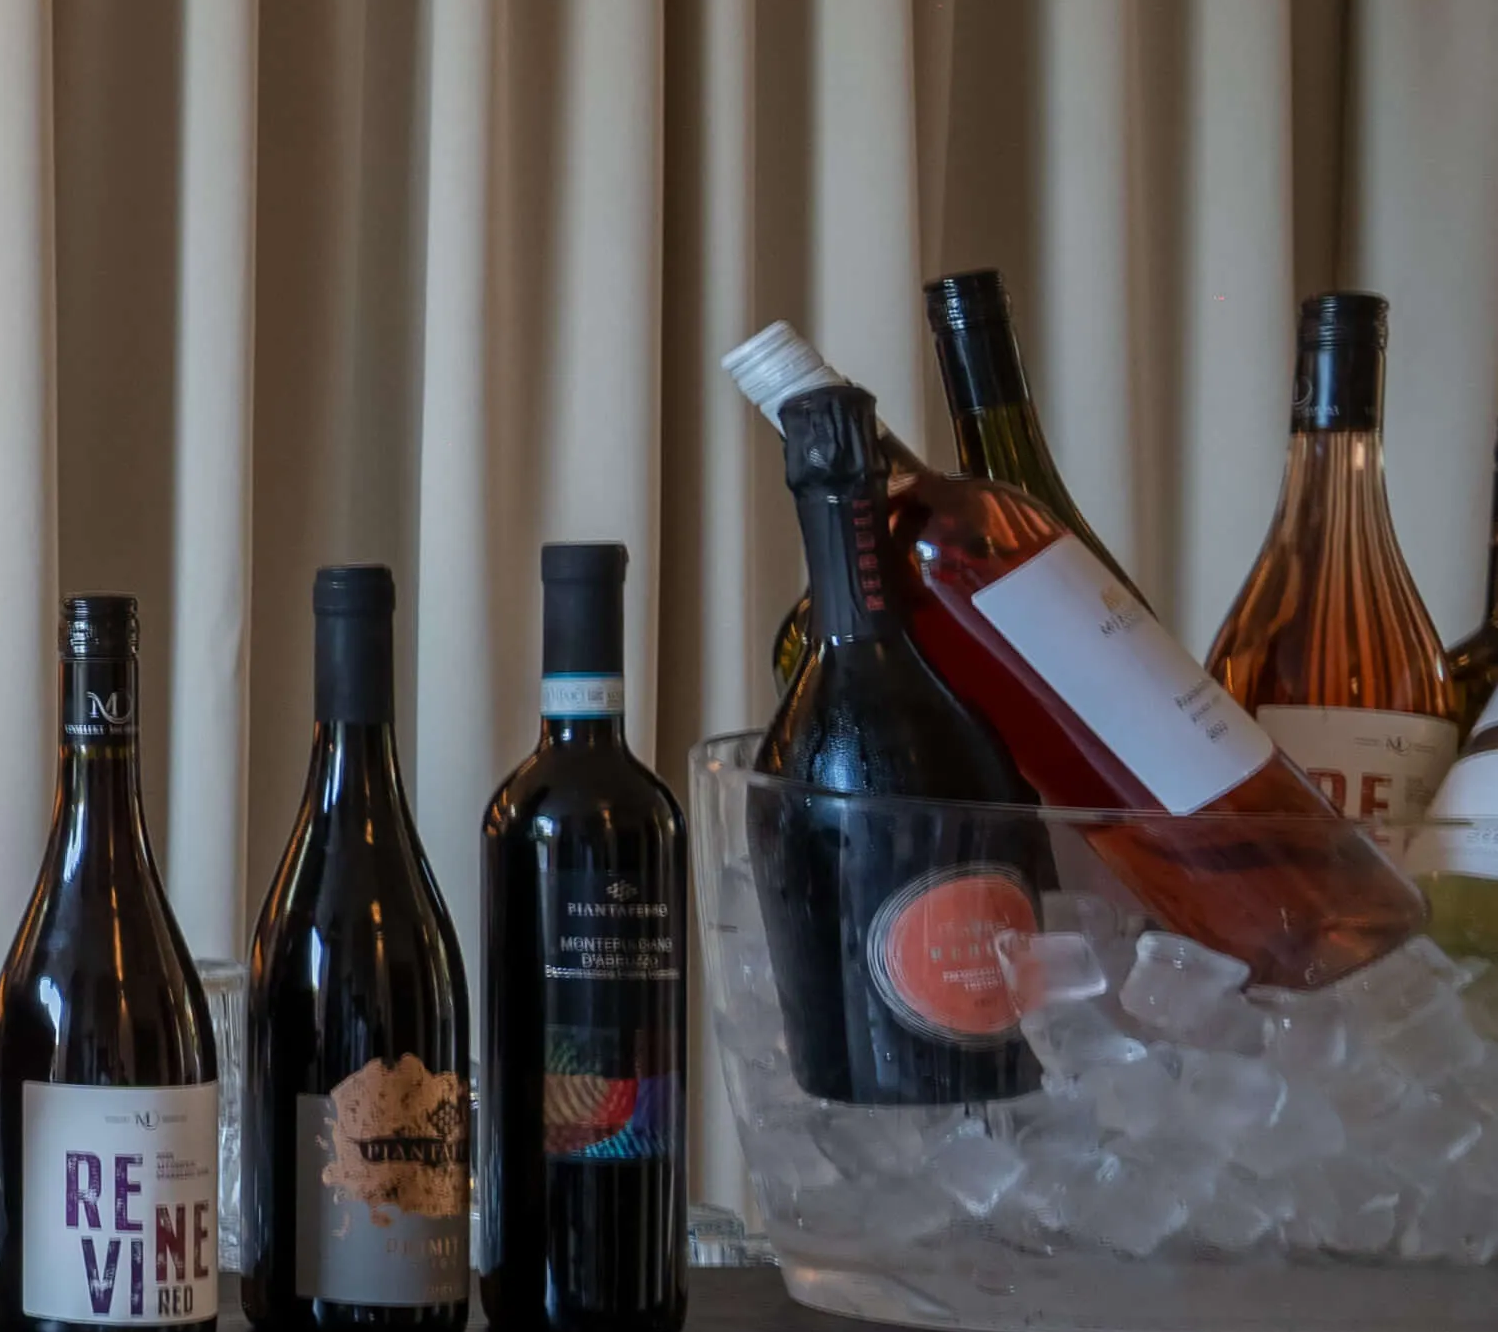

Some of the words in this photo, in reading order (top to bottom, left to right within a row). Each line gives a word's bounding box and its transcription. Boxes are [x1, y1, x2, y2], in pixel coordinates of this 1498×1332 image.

[66, 1150, 144, 1232] RE
[80, 1237, 144, 1318] VI
[155, 1199, 210, 1283] NE
[157, 1286, 194, 1317] RED
